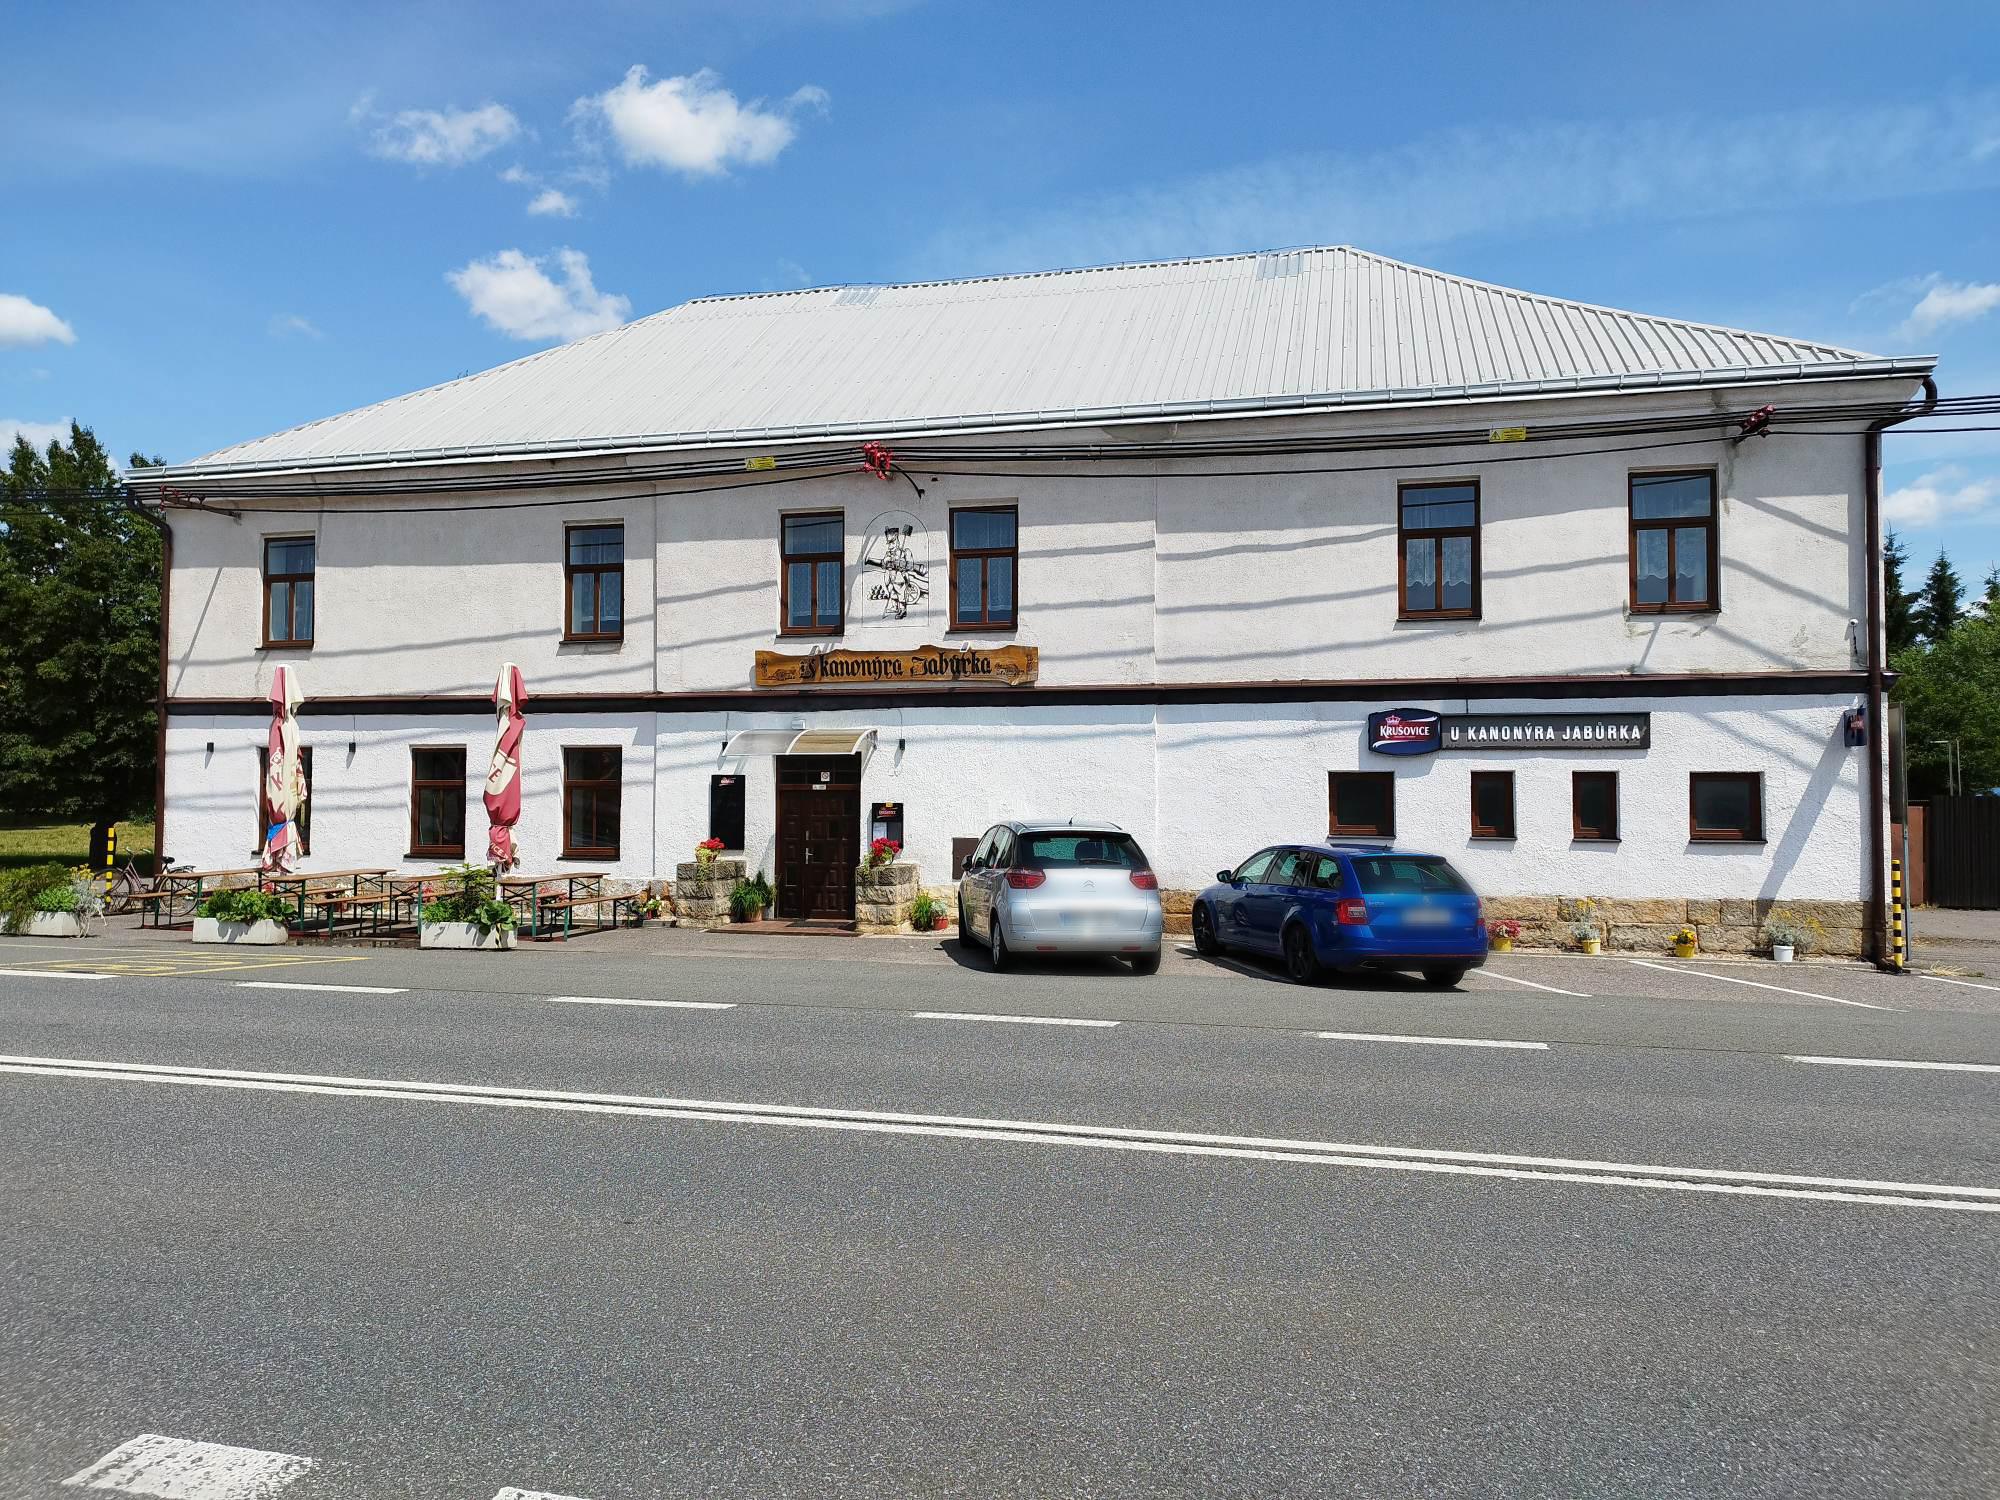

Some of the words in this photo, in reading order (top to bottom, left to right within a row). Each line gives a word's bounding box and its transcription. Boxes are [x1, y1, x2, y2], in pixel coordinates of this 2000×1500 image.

[1380, 724, 1430, 739] KRUŠOVICE
[1450, 726, 1460, 742] U
[1467, 722, 1555, 743] KANONÝRA
[1562, 721, 1642, 743] JABŮRKA
